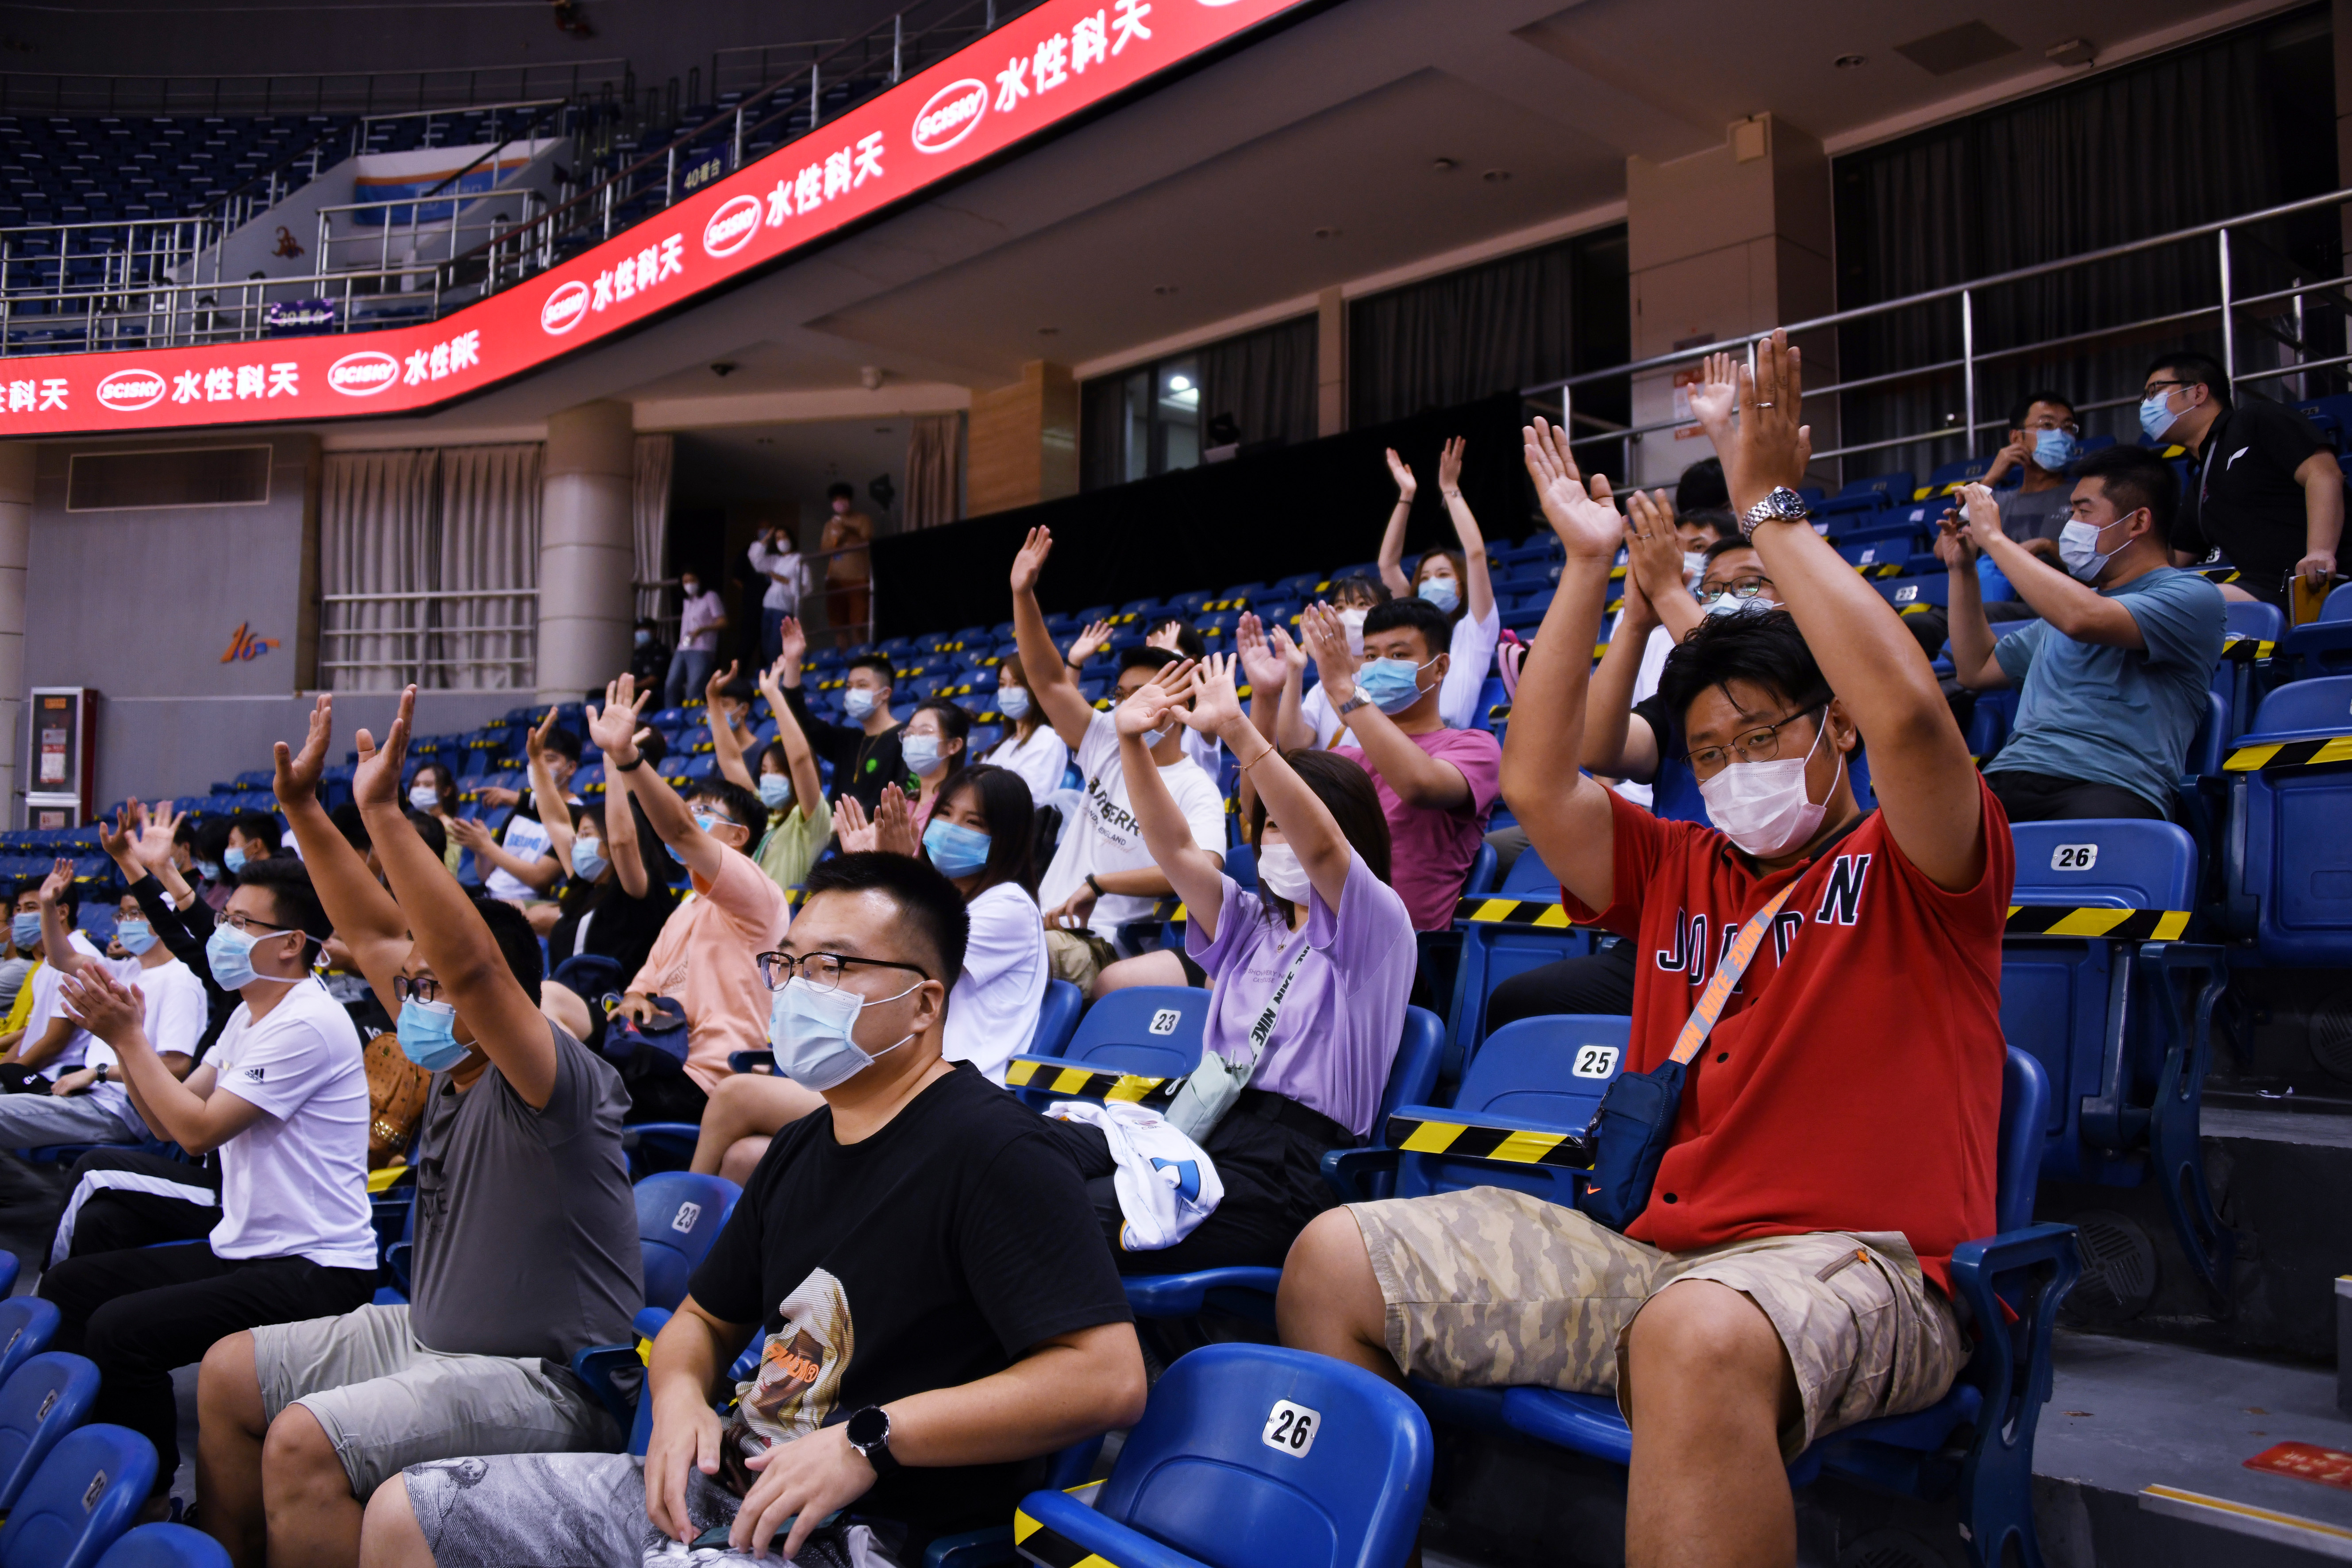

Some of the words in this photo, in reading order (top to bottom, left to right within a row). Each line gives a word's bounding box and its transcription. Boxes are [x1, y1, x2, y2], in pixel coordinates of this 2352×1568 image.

[995, 0, 1152, 112] 水性科天
[917, 89, 983, 141] SCISKY
[766, 131, 884, 227] 水性科天
[707, 205, 757, 247] SCISKY
[592, 233, 683, 311] 水性科天
[544, 291, 585, 325] SCISKY
[102, 381, 161, 399] SCISKY
[172, 362, 298, 404] 水性科天
[333, 364, 394, 384] SCISKY
[0, 378, 68, 412] 科天
[2059, 848, 2090, 867] 26
[1728, 919, 1764, 971] NIKE
[1273, 971, 1294, 1005] NIKE
[1698, 969, 1734, 1025] NIKE
[1154, 1013, 1176, 1032] 23
[1251, 1007, 1276, 1047] NIKE
[1671, 1021, 1704, 1064] NIK
[1580, 1051, 1612, 1074] 25
[677, 1206, 697, 1229] 23
[1270, 1410, 1311, 1449] 26
